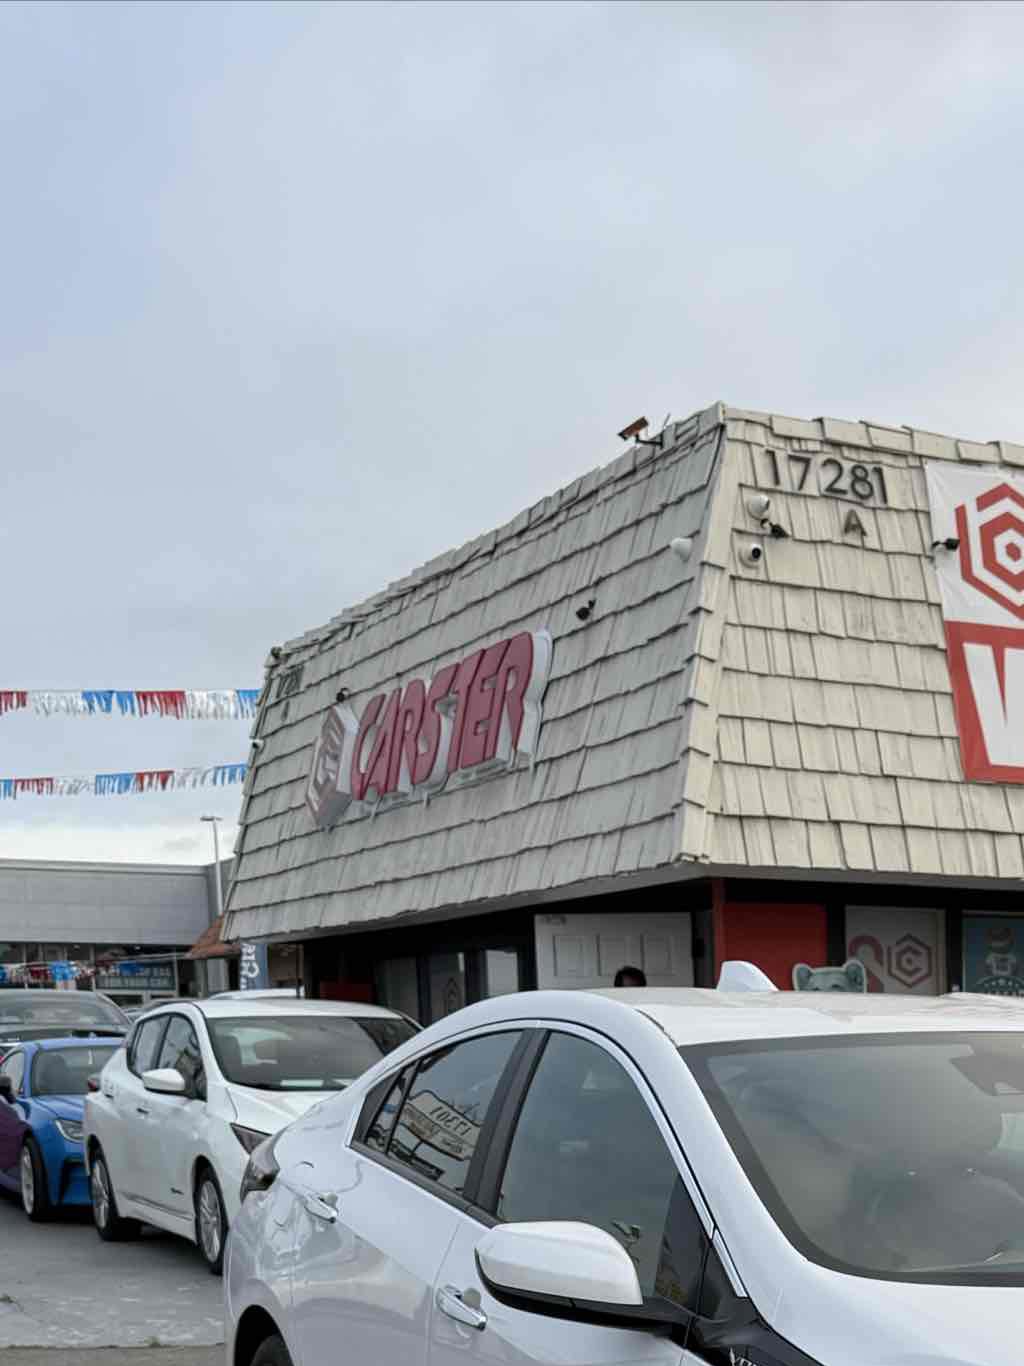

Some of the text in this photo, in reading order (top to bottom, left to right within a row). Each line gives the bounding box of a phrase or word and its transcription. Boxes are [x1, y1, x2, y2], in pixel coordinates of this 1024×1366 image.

[765, 449, 888, 505] 17281
[843, 509, 868, 537] A
[350, 630, 537, 801] CARSTER
